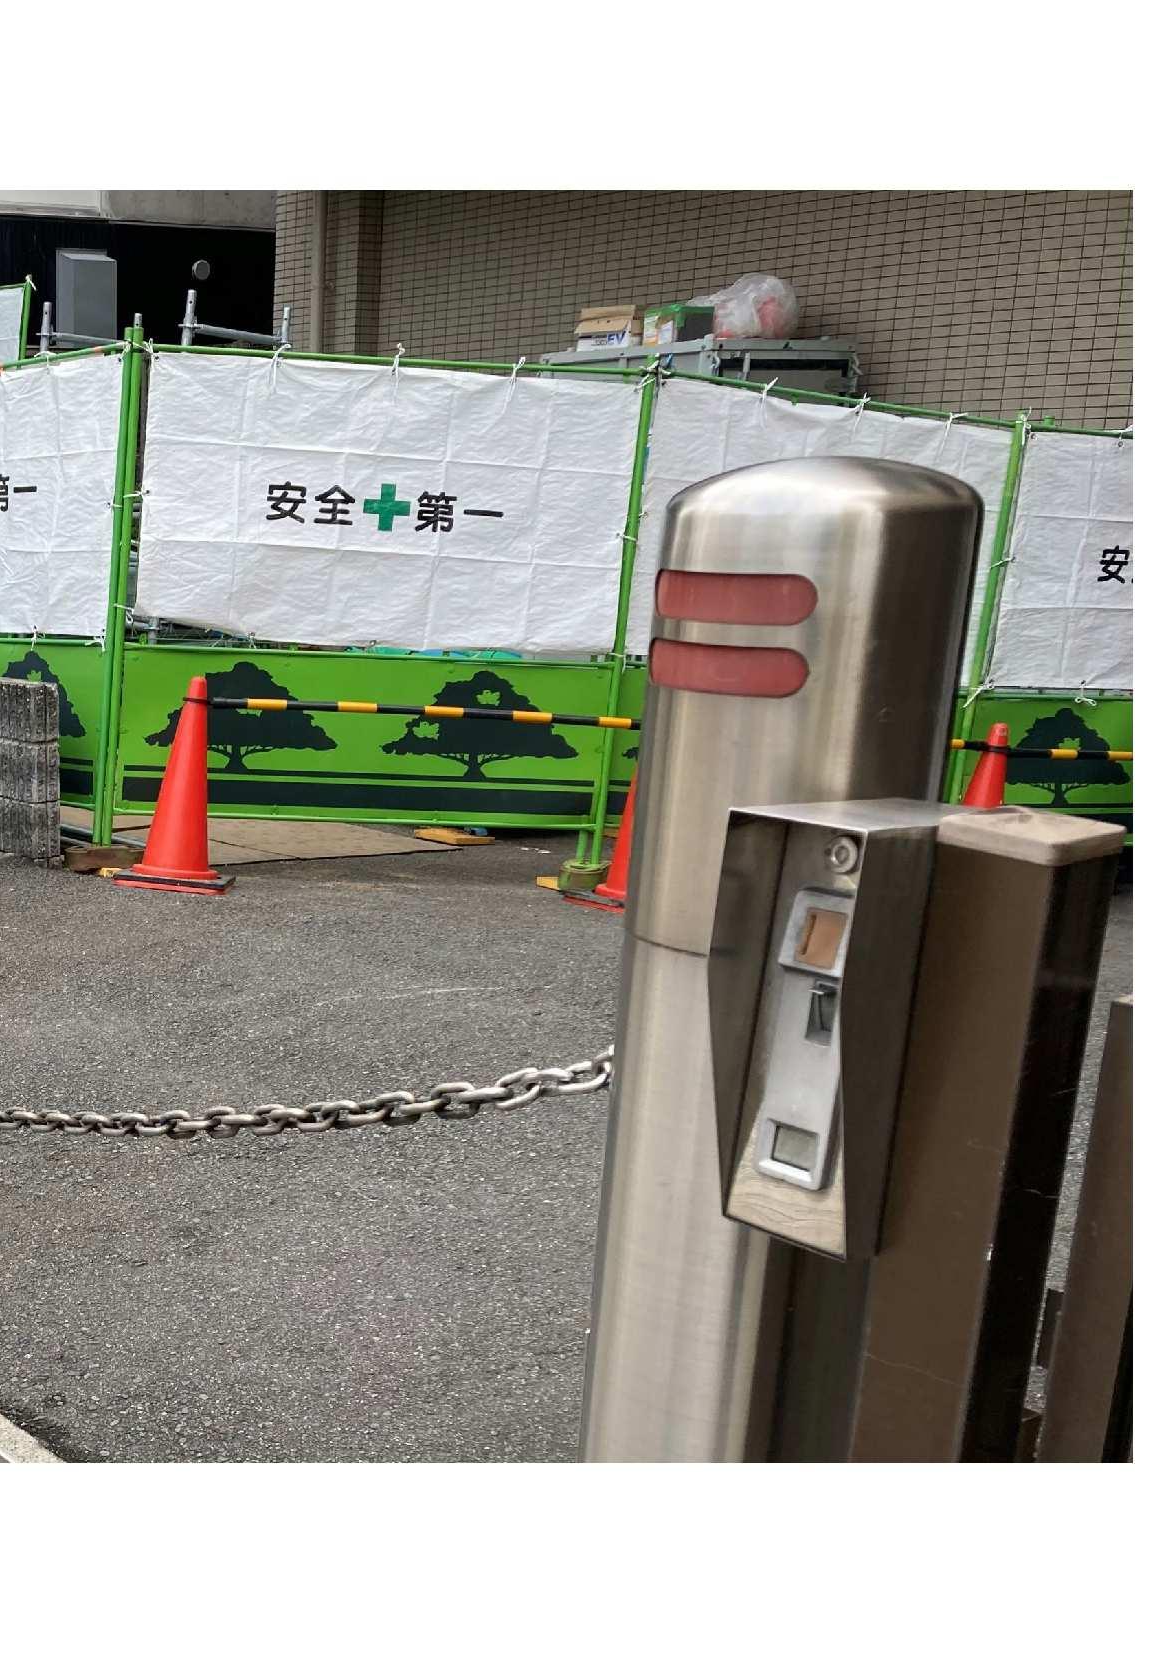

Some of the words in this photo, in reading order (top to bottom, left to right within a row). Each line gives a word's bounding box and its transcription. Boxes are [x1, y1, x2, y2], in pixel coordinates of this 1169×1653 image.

[607, 331, 627, 345] EV
[265, 481, 356, 526] 安全
[414, 491, 504, 533] 第一
[1097, 545, 1133, 584] 安
